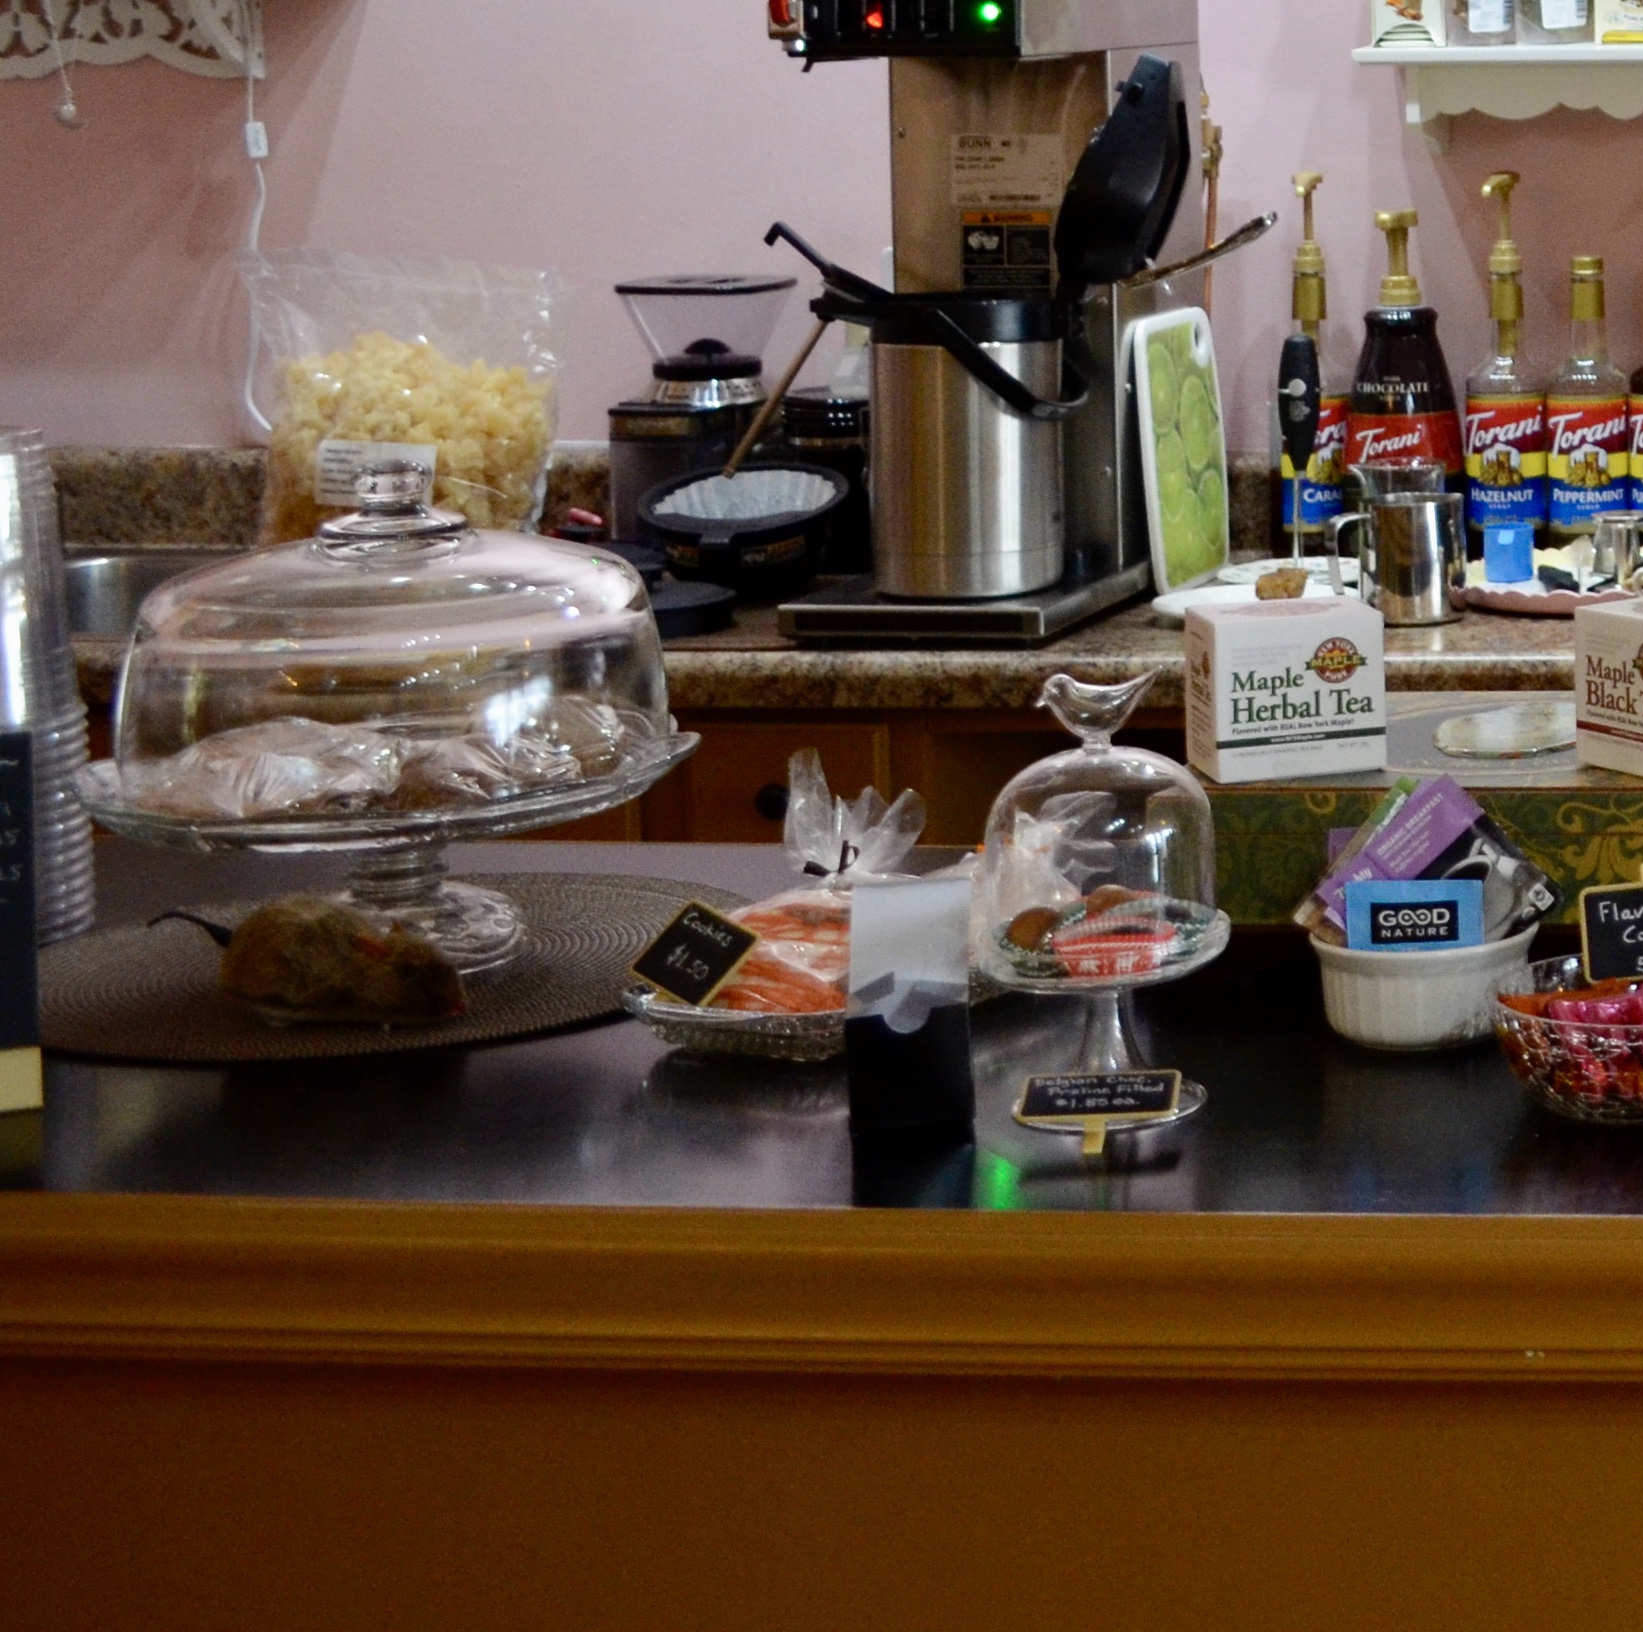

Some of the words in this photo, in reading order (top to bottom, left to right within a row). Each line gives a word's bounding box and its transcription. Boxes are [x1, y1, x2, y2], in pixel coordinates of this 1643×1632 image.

[1357, 382, 1429, 393] CHOCOLATE
[1466, 405, 1542, 457] Torani
[1548, 405, 1627, 460] Torani
[1356, 423, 1423, 464] Torani
[1303, 488, 1343, 503] CARA
[1471, 487, 1535, 503] HAZELNUT
[1553, 488, 1624, 503] PEPPERMINT
[1318, 640, 1334, 657] NEW
[1335, 640, 1356, 655] YORK
[1311, 655, 1362, 668] MAPLE
[1586, 654, 1636, 689] Maple
[1231, 667, 1305, 697] Maple
[1585, 679, 1639, 716] Black
[1230, 690, 1323, 725] Herbal
[1329, 688, 1375, 715] Tea
[1232, 726, 1262, 735] Flavored
[1263, 725, 1279, 733] with
[1314, 720, 1329, 728] York
[1378, 908, 1451, 927] GOOD
[683, 911, 733, 947] Cookies
[1381, 927, 1449, 938] NATURE
[1034, 1076, 1099, 1089] Belgian
[1047, 1086, 1112, 1097] Praline
[1117, 1082, 1165, 1094] Filled
